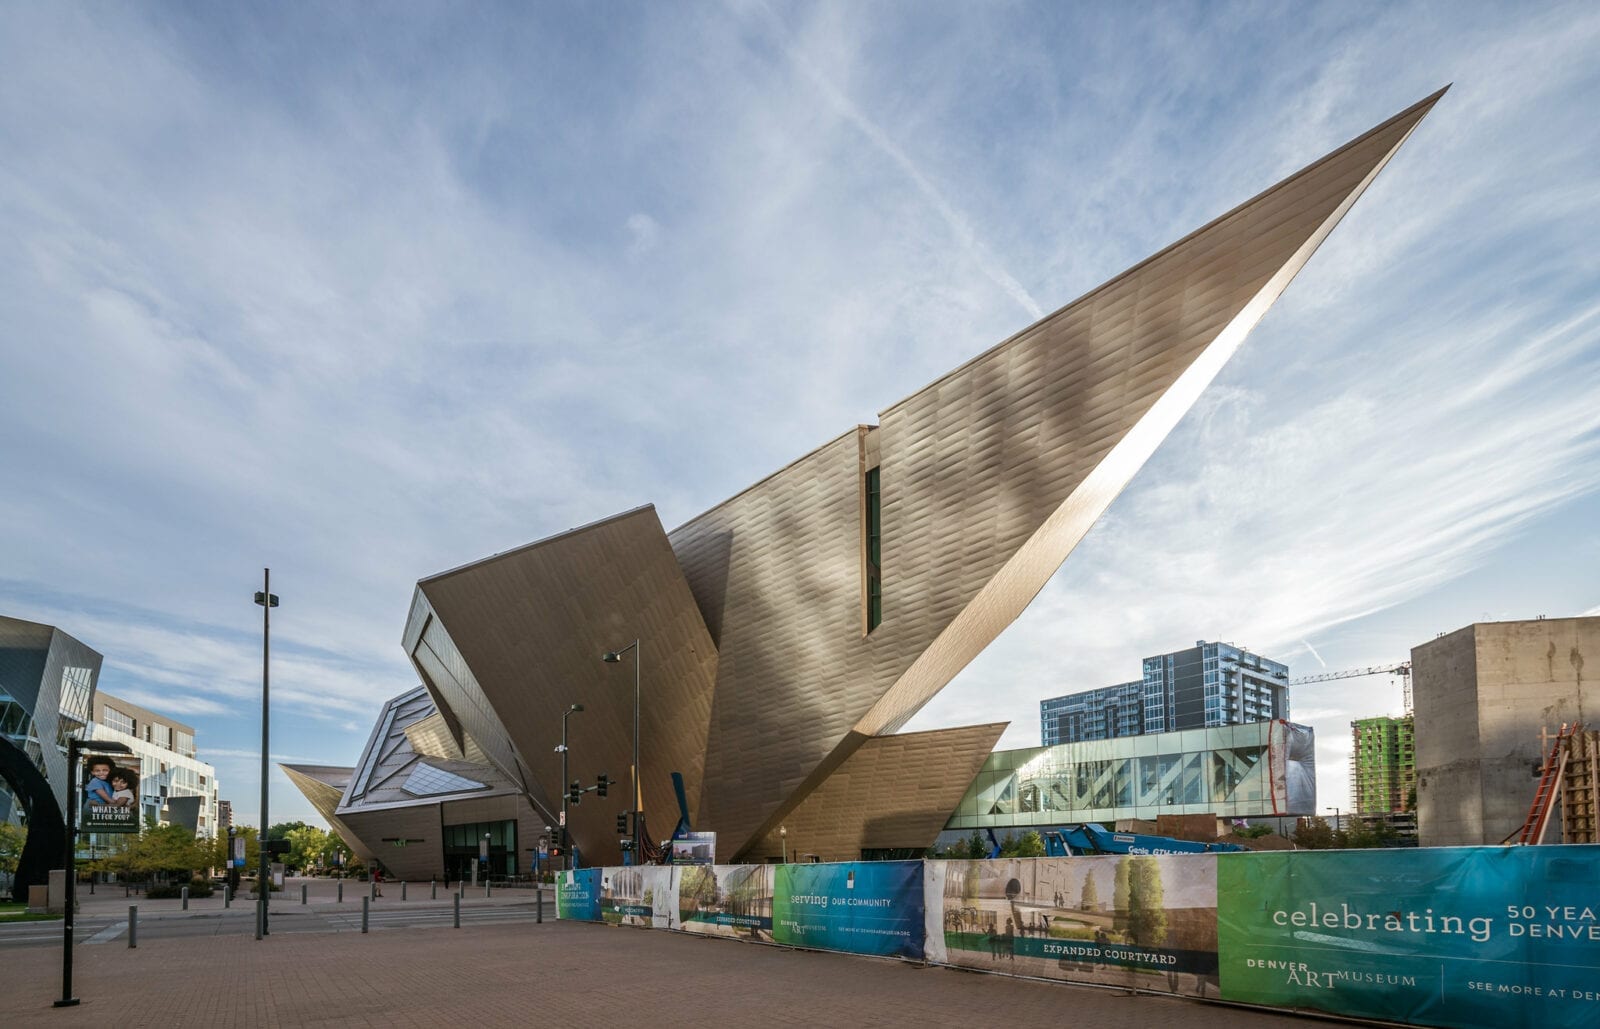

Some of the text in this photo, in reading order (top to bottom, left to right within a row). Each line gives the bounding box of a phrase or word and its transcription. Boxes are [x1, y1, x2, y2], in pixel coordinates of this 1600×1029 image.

[92, 806, 118, 814] WHAT'S
[791, 893, 891, 908] serving OUR COMMUNITY
[1273, 902, 1596, 943] celebrating 50 YEA
[1509, 923, 1600, 940] DENVE
[1043, 944, 1177, 965] EXPANDED COURTYARD
[1247, 958, 1308, 972] DENVER
[1286, 969, 1416, 989] ART MUSEUM
[1468, 981, 1493, 991] SEE
[1498, 984, 1542, 996] MORE
[1548, 989, 1566, 998] AT
